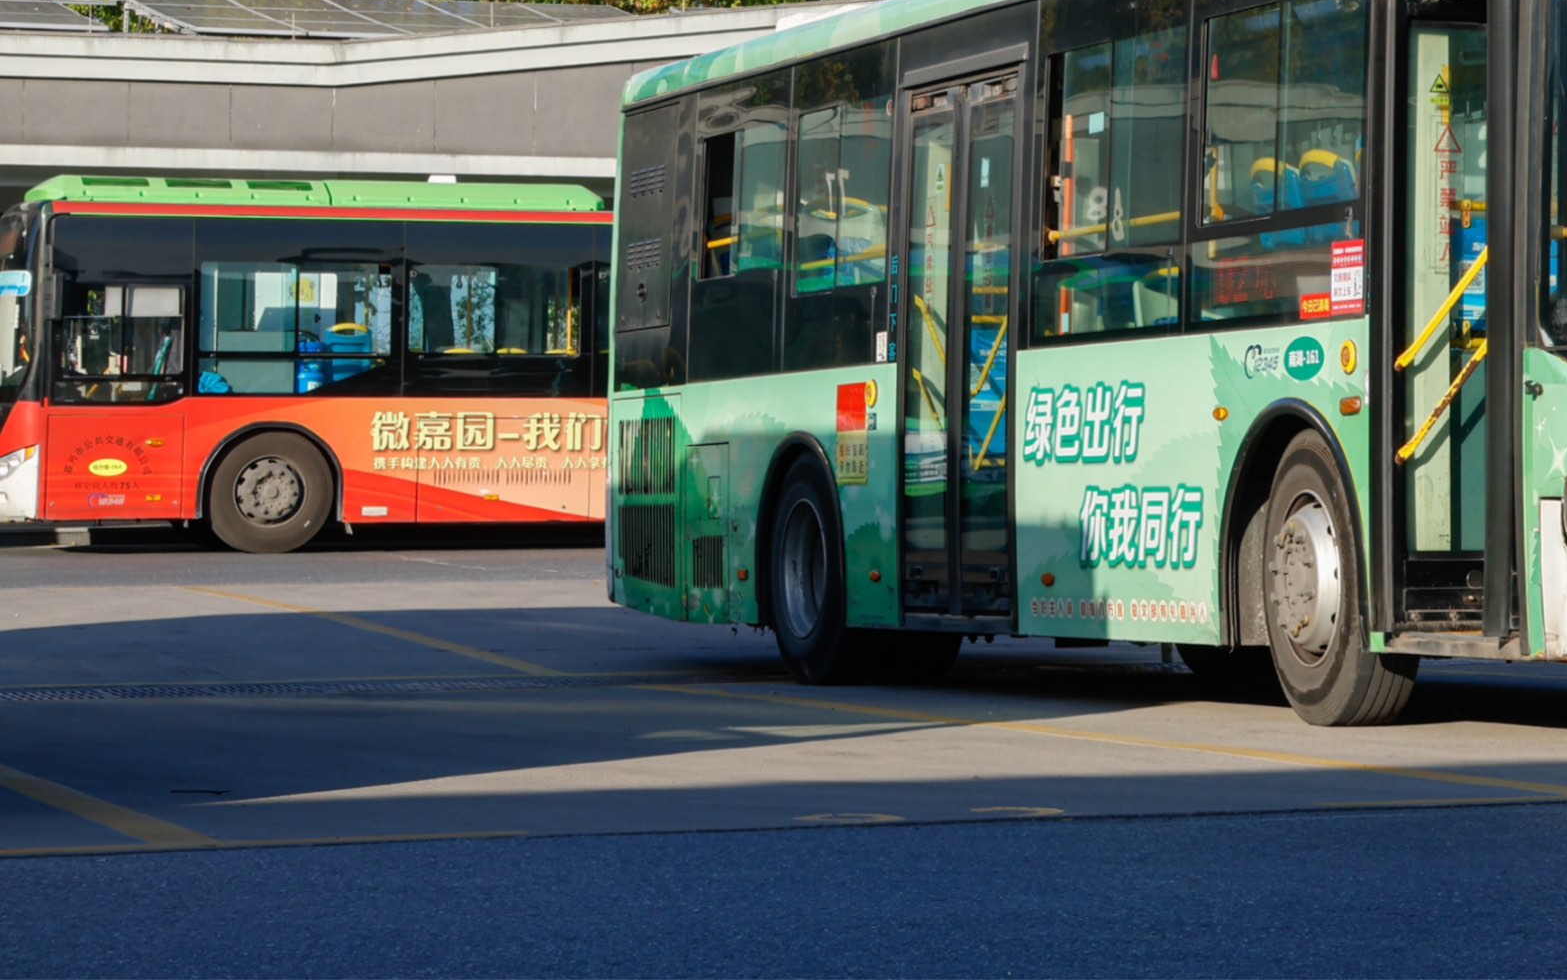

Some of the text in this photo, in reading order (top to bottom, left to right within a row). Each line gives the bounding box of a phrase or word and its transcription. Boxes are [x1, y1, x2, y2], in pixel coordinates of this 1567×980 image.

[1253, 355, 1280, 373] 12345
[1023, 380, 1145, 465] 绿色出行
[1079, 483, 1204, 569] 你我同行
